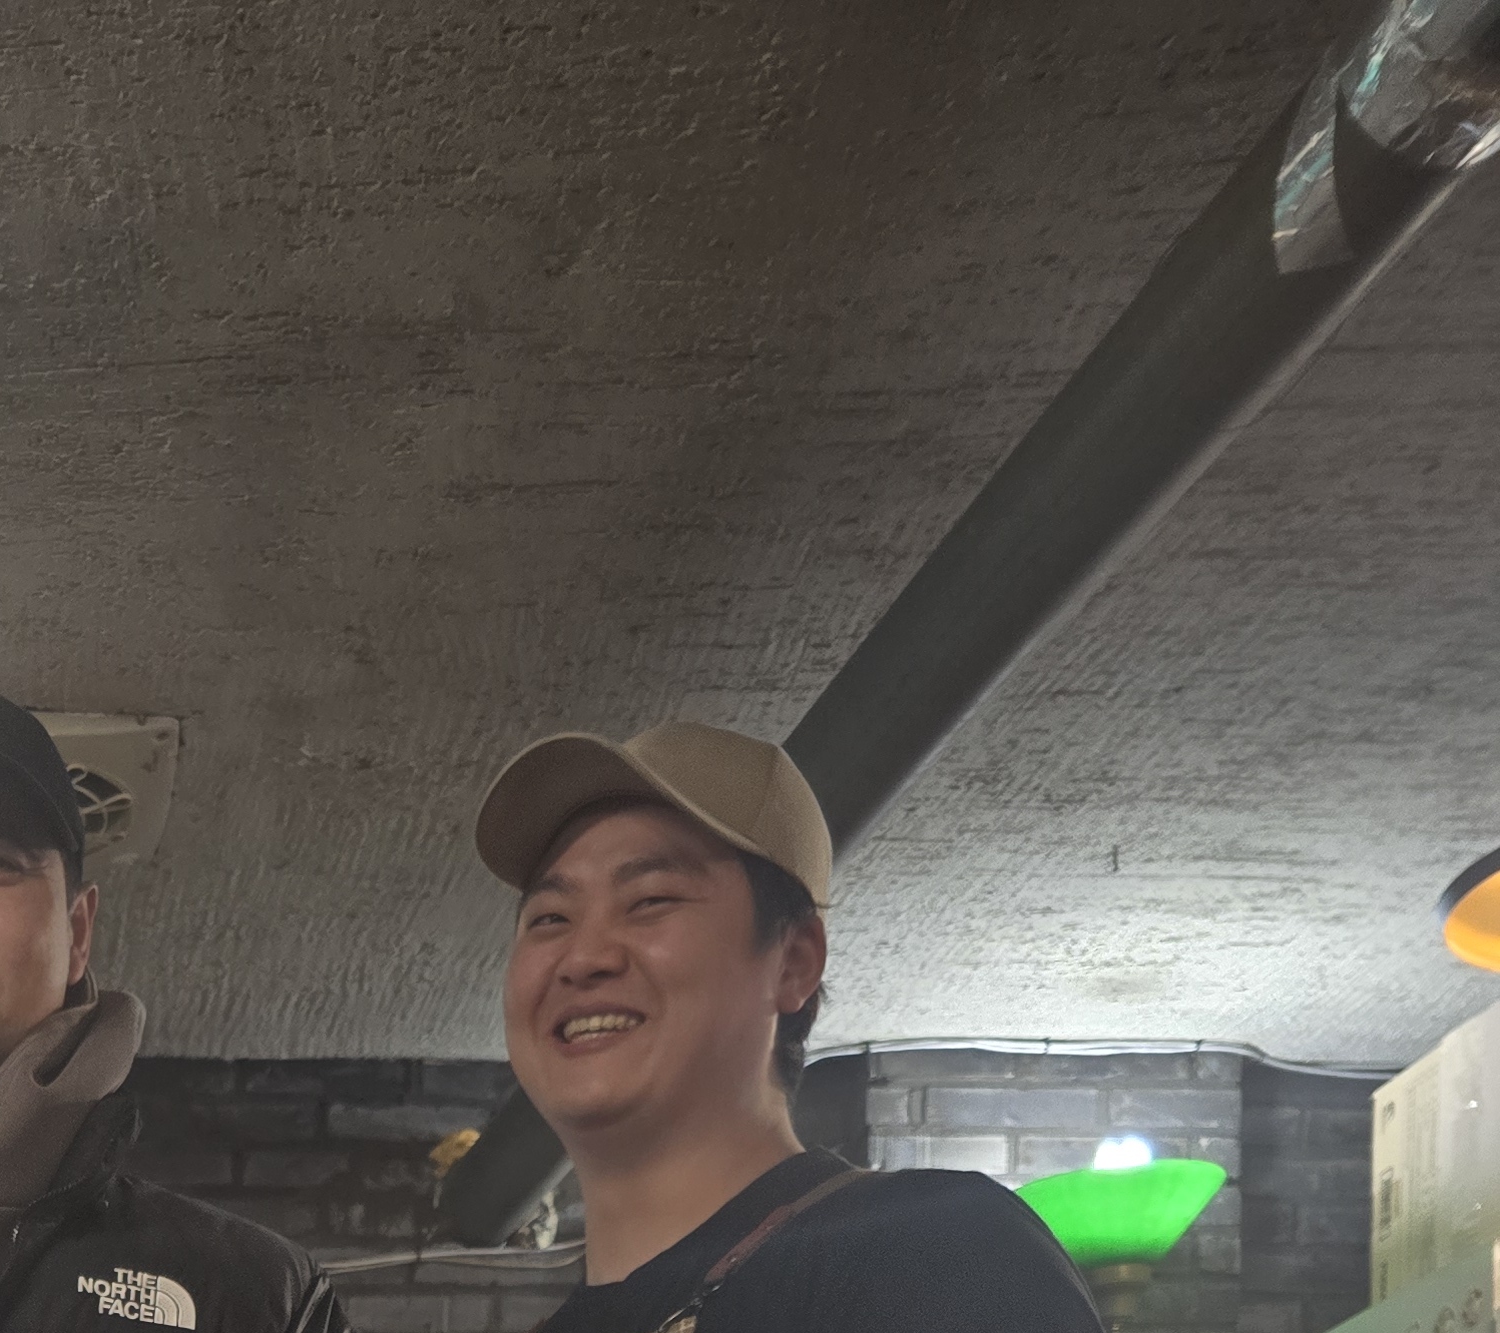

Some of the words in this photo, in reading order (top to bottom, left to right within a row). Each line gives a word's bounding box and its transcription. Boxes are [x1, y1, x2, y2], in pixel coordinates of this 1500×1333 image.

[77, 1275, 156, 1306] NORTH
[113, 1267, 158, 1289] THE
[98, 1296, 155, 1324] FACE
